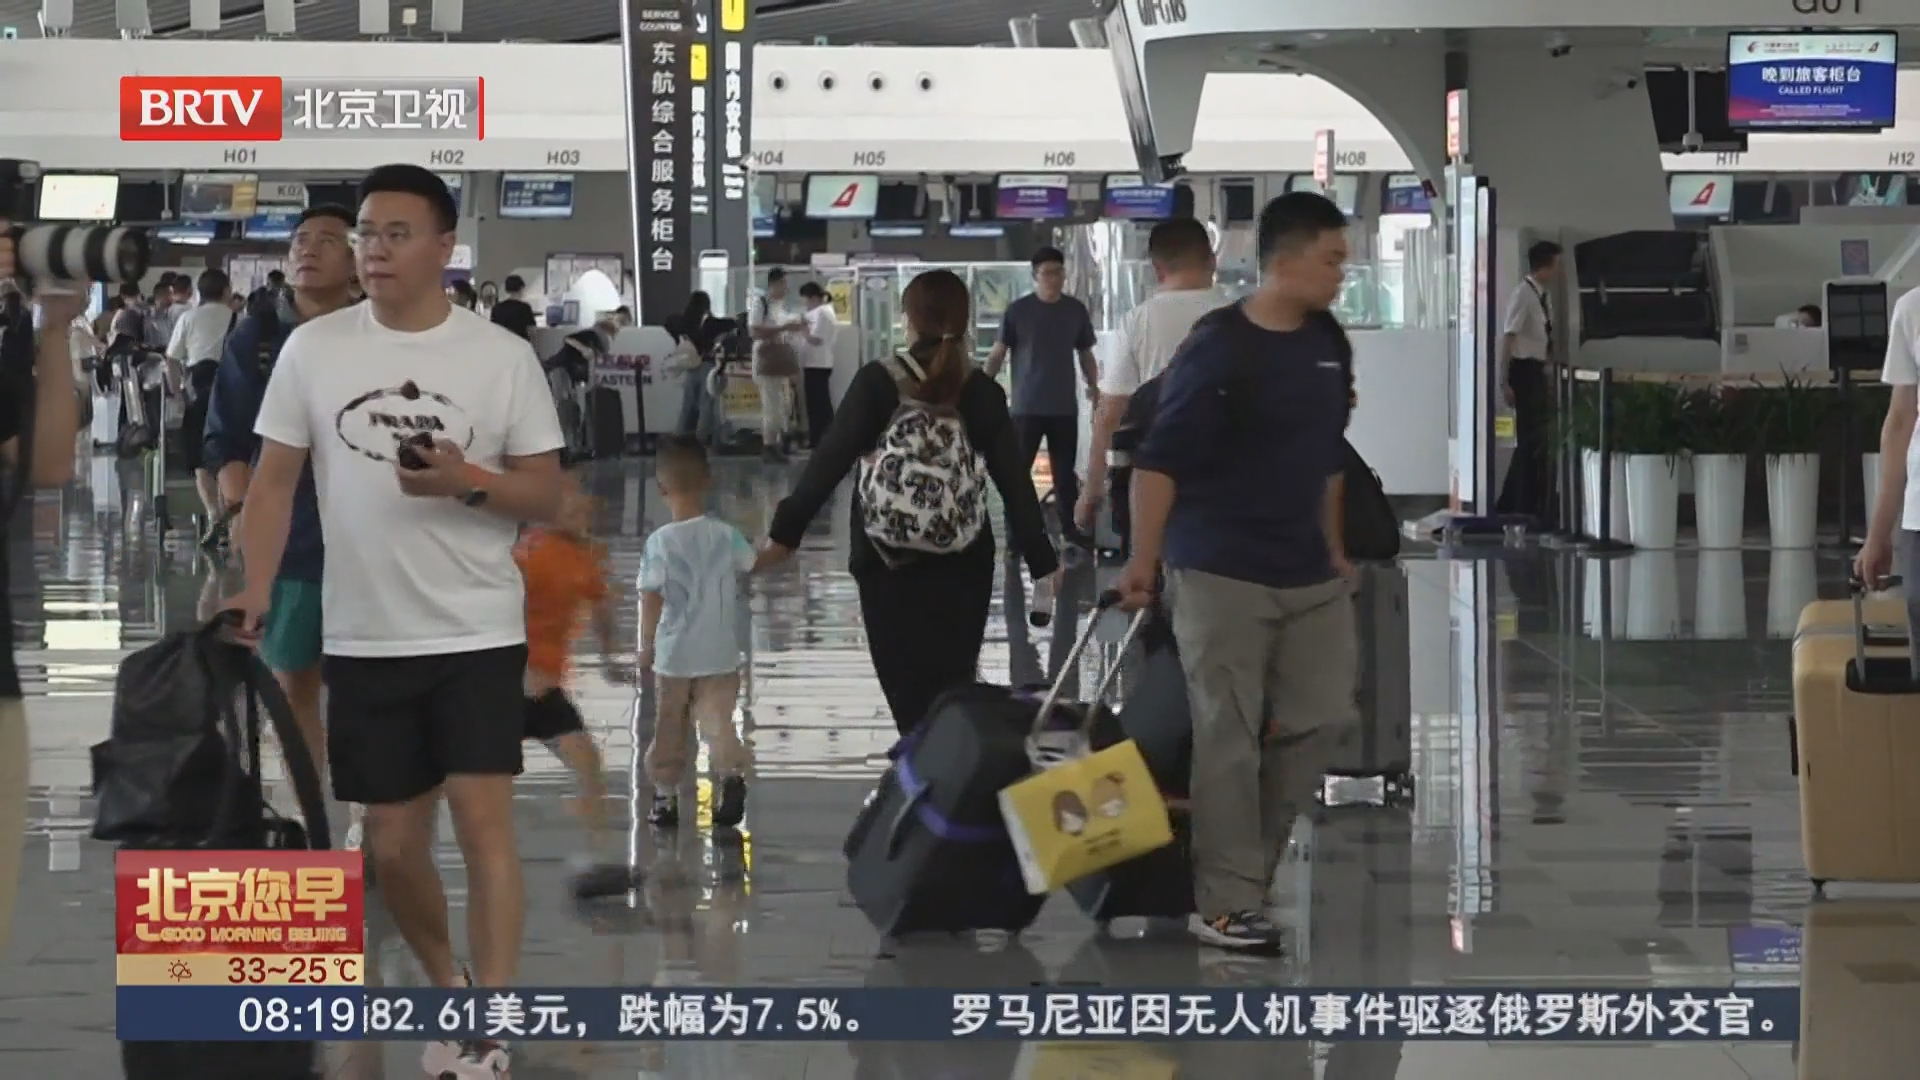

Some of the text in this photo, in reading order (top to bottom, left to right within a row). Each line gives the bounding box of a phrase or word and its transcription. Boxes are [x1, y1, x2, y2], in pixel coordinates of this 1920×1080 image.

[642, 9, 680, 20] SERVICE
[639, 22, 683, 32] COUNTER
[1762, 66, 1861, 83] 晚到旅客柜台
[1778, 85, 1845, 95] CALLED FLIGHT
[223, 149, 257, 164] H01
[431, 149, 465, 165] H02
[547, 149, 581, 165] H03
[651, 41, 675, 271] 东航综合服务柜台
[853, 150, 886, 166] H05
[1043, 150, 1076, 167] H06
[1336, 150, 1367, 166] H08
[1888, 151, 1916, 166] H12
